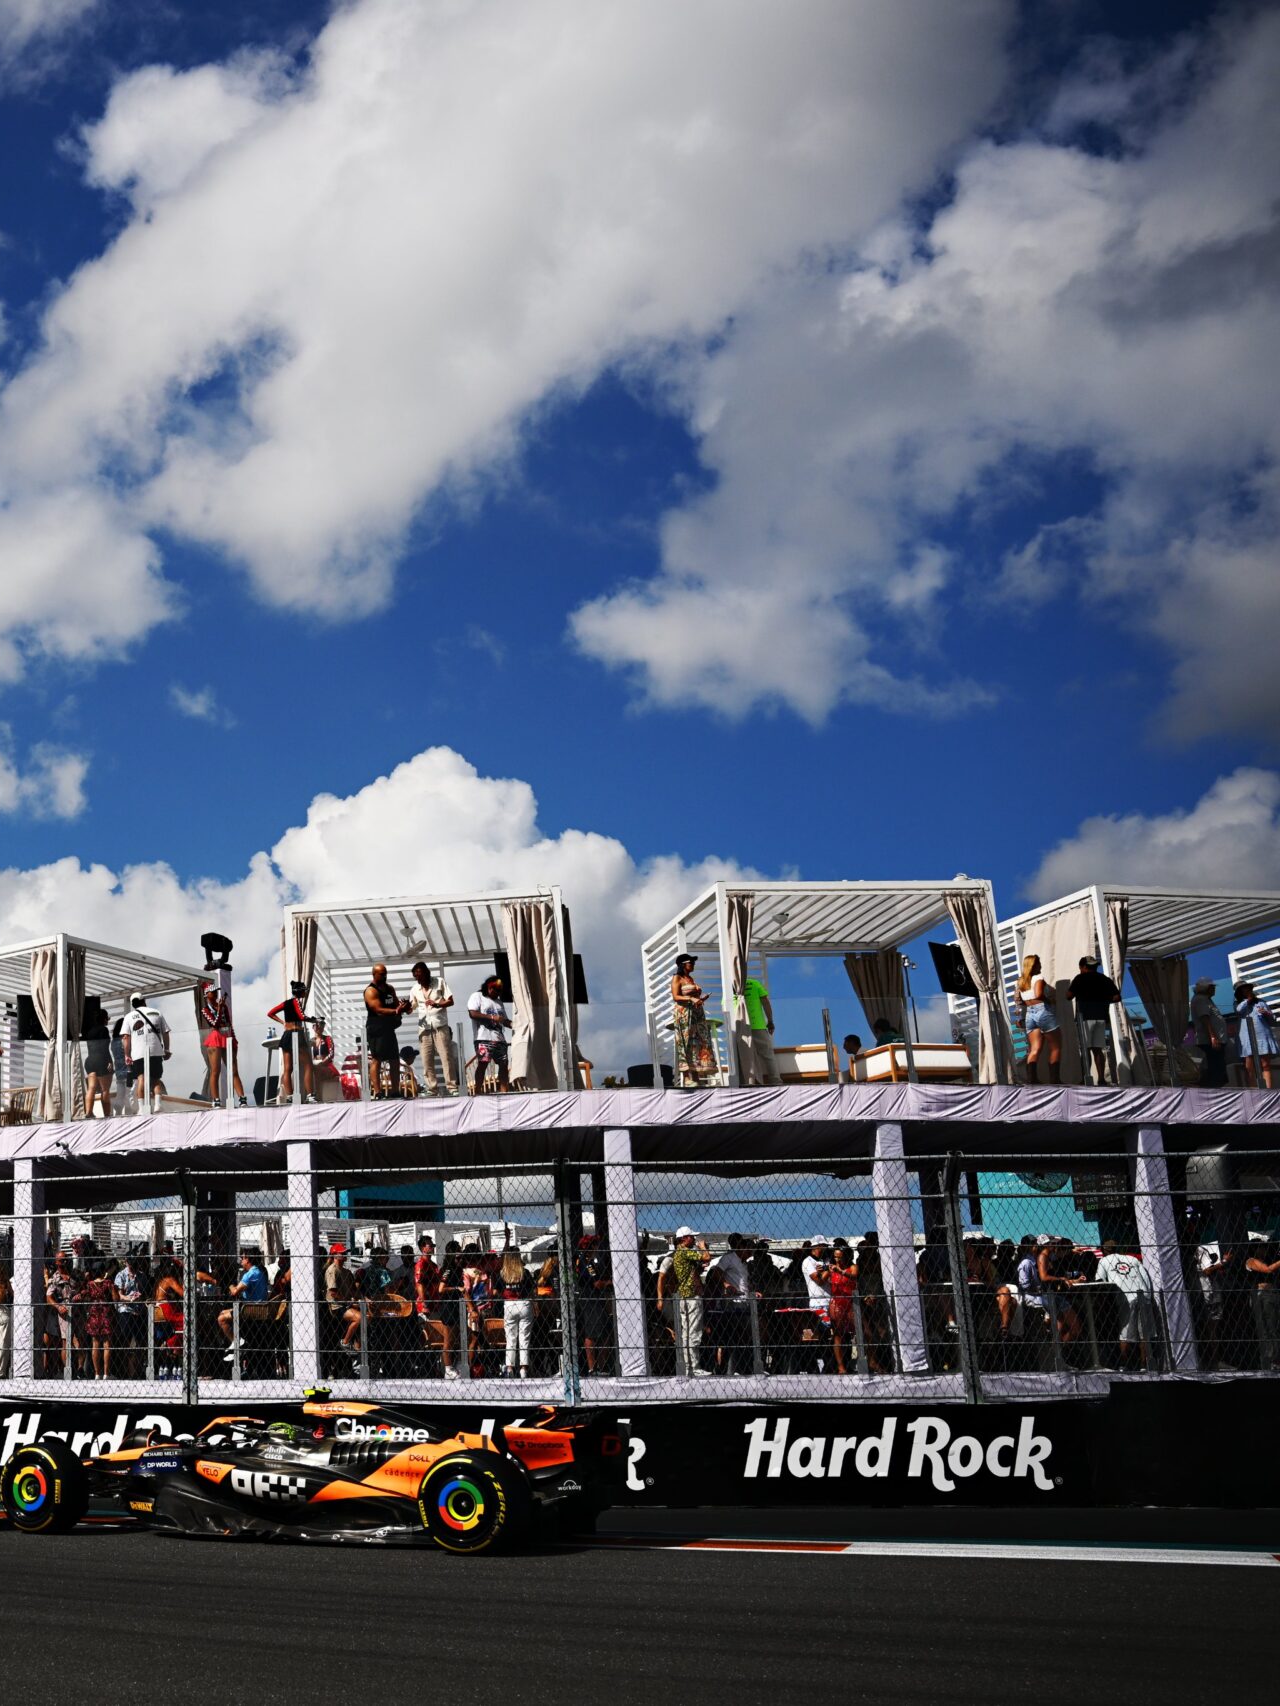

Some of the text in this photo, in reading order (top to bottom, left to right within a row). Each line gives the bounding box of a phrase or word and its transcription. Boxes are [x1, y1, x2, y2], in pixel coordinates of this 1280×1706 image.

[335, 1418, 430, 1443] Chrome
[409, 1454, 431, 1463] DELL
[528, 1441, 565, 1449] Dropbox
[743, 1416, 1055, 1492] Hard Rock
[231, 1469, 306, 1500] OKX
[493, 1481, 506, 1524] ZERO
